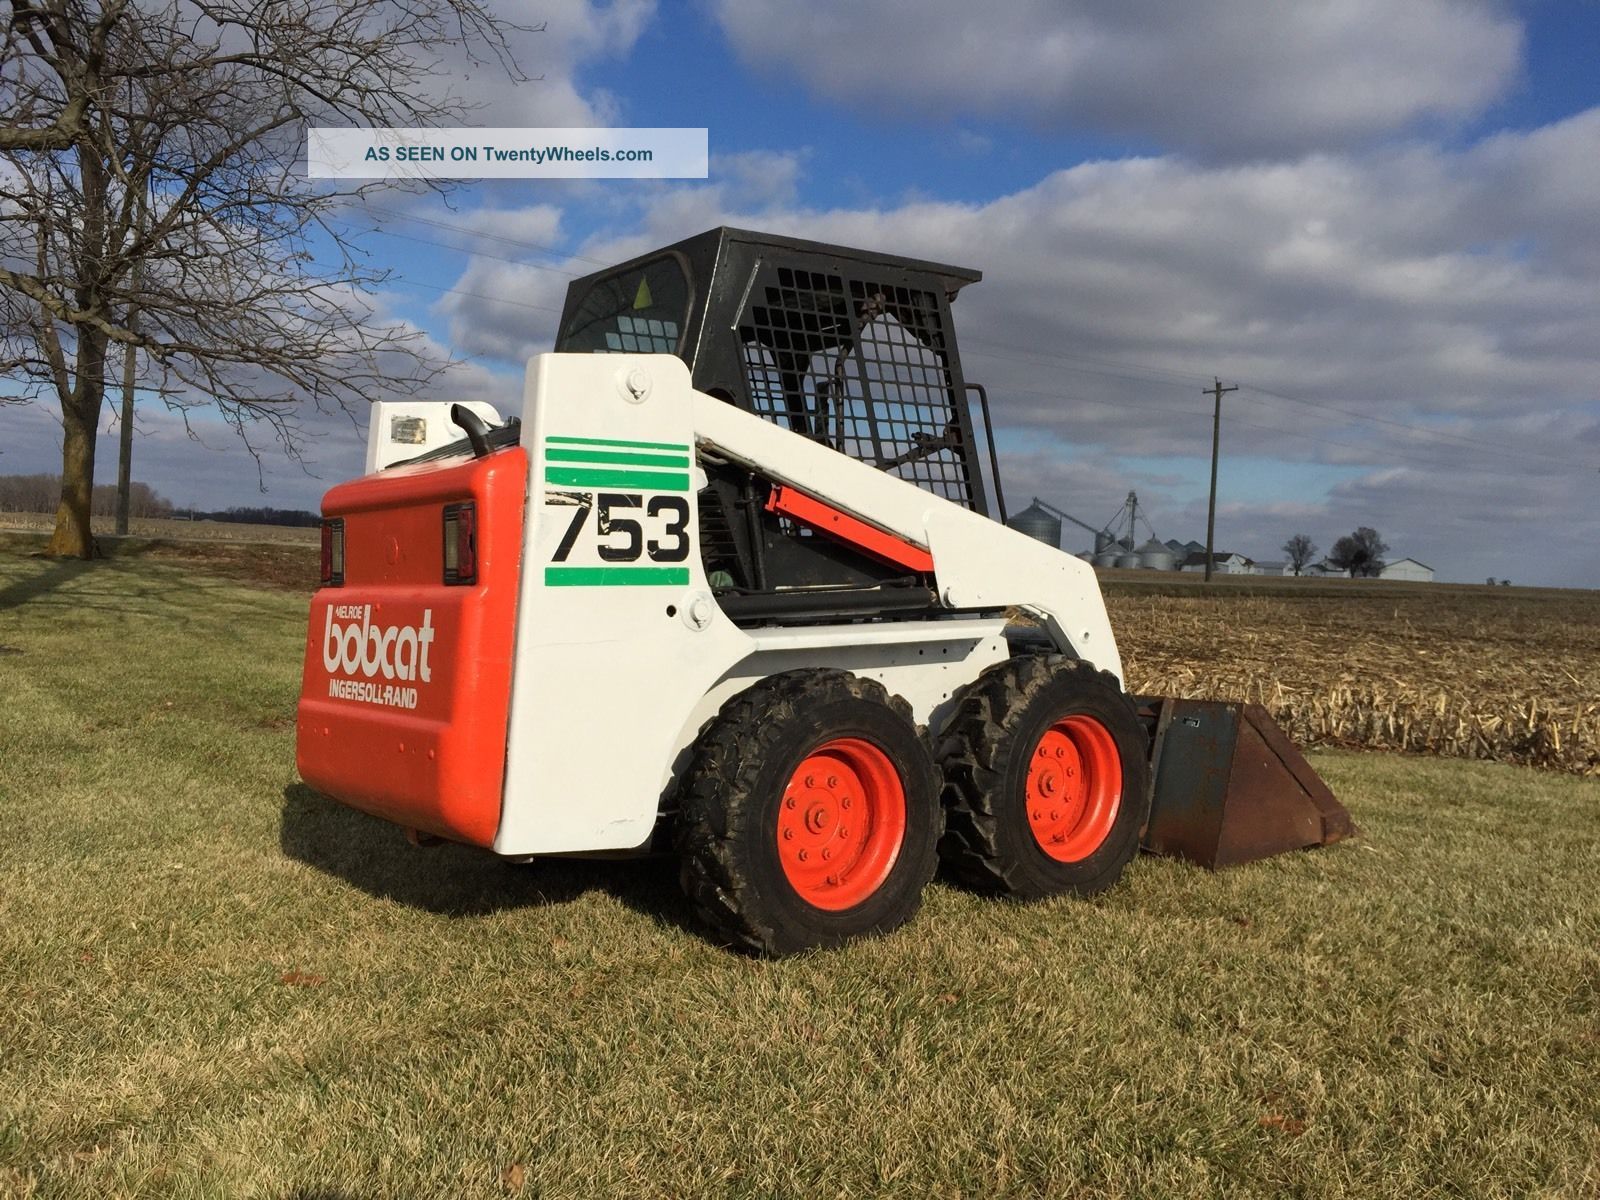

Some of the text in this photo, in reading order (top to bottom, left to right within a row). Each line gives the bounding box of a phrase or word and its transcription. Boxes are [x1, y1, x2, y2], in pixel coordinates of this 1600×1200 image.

[545, 490, 690, 562] 753
[335, 605, 363, 619] MELROE
[323, 604, 435, 682] bobcat
[328, 678, 418, 709] INGERSOLL-RAND
